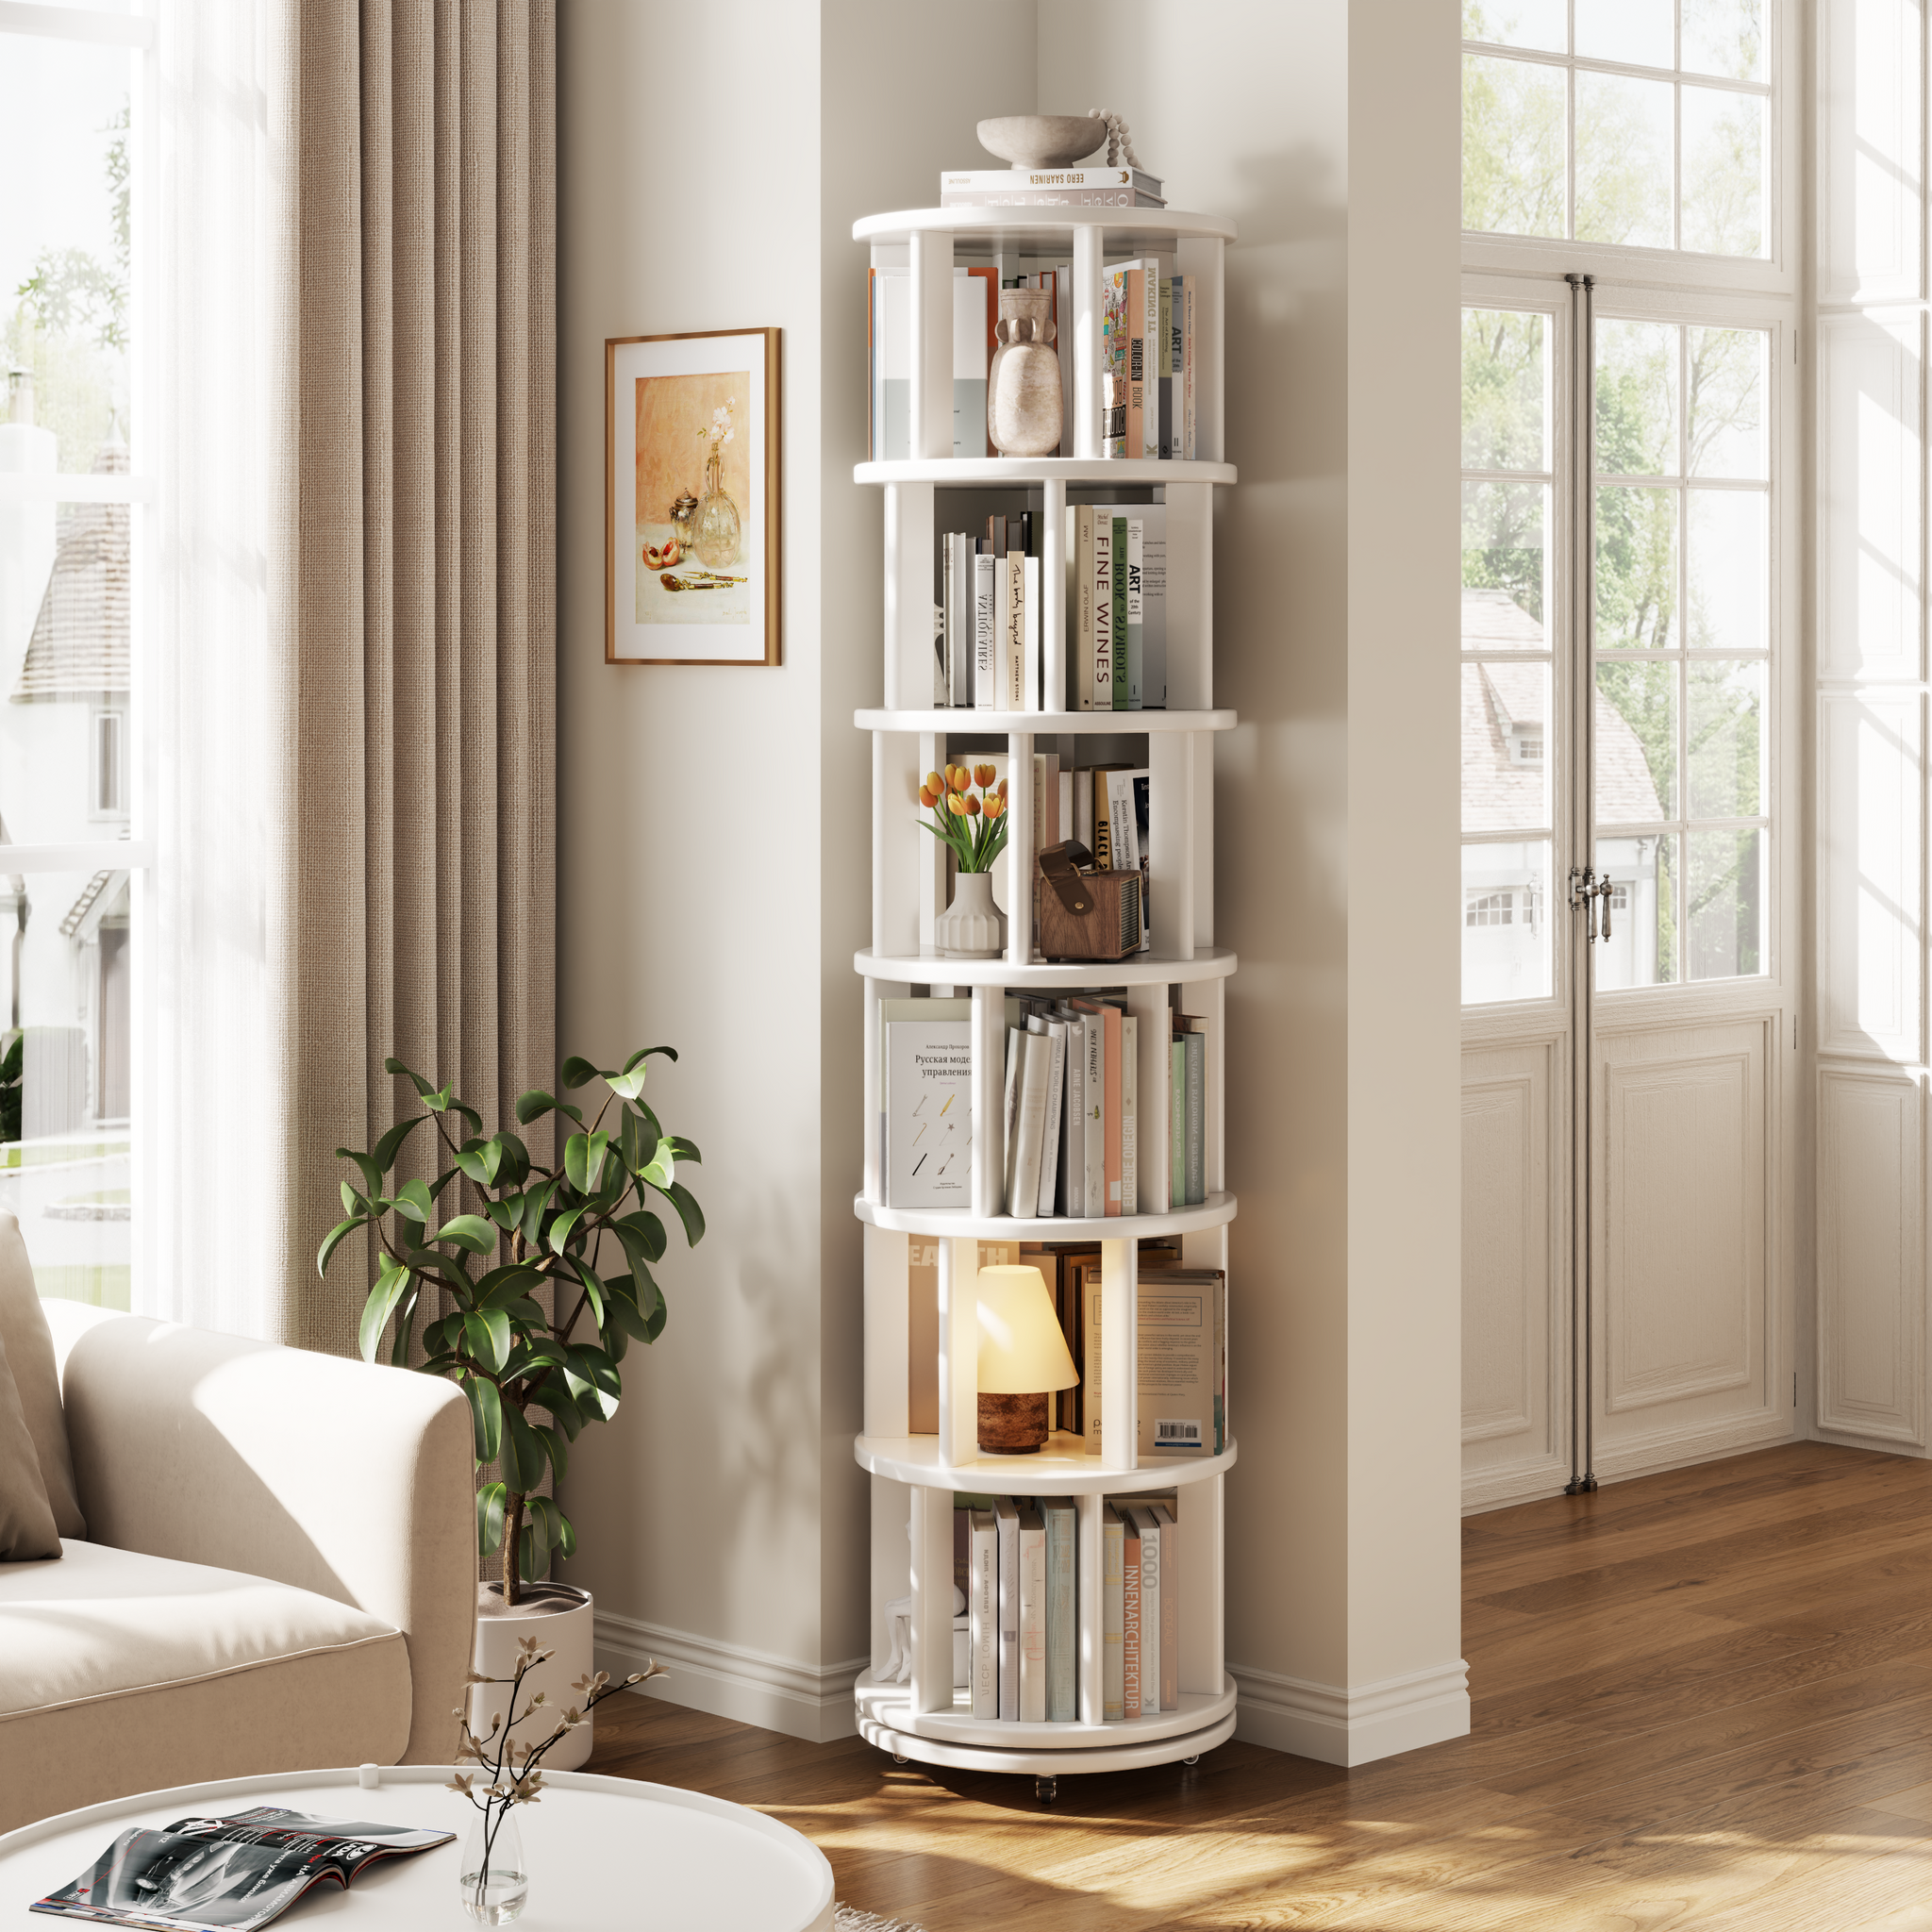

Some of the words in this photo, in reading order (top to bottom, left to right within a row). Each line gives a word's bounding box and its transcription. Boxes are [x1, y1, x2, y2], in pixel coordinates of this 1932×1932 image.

[1029, 174, 1065, 185] SAARINEN
[1067, 173, 1084, 183] EERO
[1172, 326, 1182, 355] ART
[1132, 387, 1143, 409] BOOK
[1083, 525, 1089, 539] AM
[1012, 564, 1021, 585] The
[1096, 537, 1109, 591] FINE
[1128, 564, 1141, 594] ART
[1012, 587, 1023, 608] body
[1008, 613, 1022, 645] beyond
[1096, 602, 1109, 683] WINES
[1098, 821, 1108, 857] BLACK
[1115, 848, 1124, 870] people
[915, 1055, 947, 1066] Русская
[950, 1057, 972, 1065] моде
[922, 1068, 972, 1078] управления
[1123, 1115, 1134, 1158] ONEGIN
[1123, 1161, 1134, 1207] EUGENE
[908, 1245, 1008, 1266] EAH
[1142, 1535, 1158, 1589] 1000
[1164, 1598, 1174, 1646] BORDEAUX
[1124, 1565, 1139, 1709] INNENARCHITEKTUR
[331, 1842, 364, 1857] LADA
[262, 1864, 276, 1880] уже
[296, 1864, 310, 1876] НА
[238, 1879, 266, 1904] близко!
[239, 1879, 297, 1926] АВИАМОТОРН
